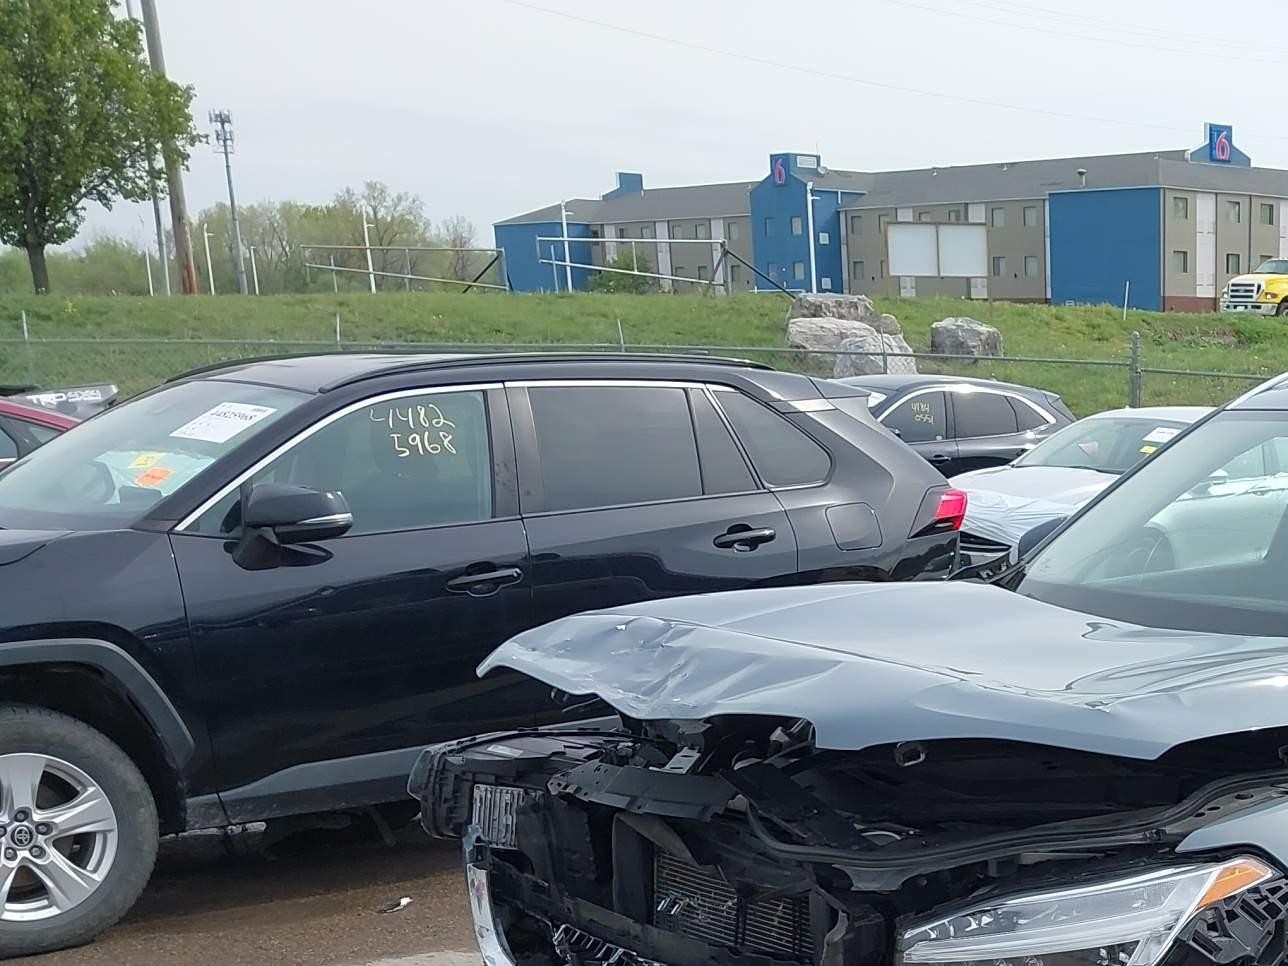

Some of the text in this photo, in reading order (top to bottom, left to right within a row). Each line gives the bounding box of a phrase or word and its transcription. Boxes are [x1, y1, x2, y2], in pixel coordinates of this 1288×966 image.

[1216, 128, 1230, 160] 6
[774, 158, 786, 185] 6
[390, 431, 457, 457] 5968
